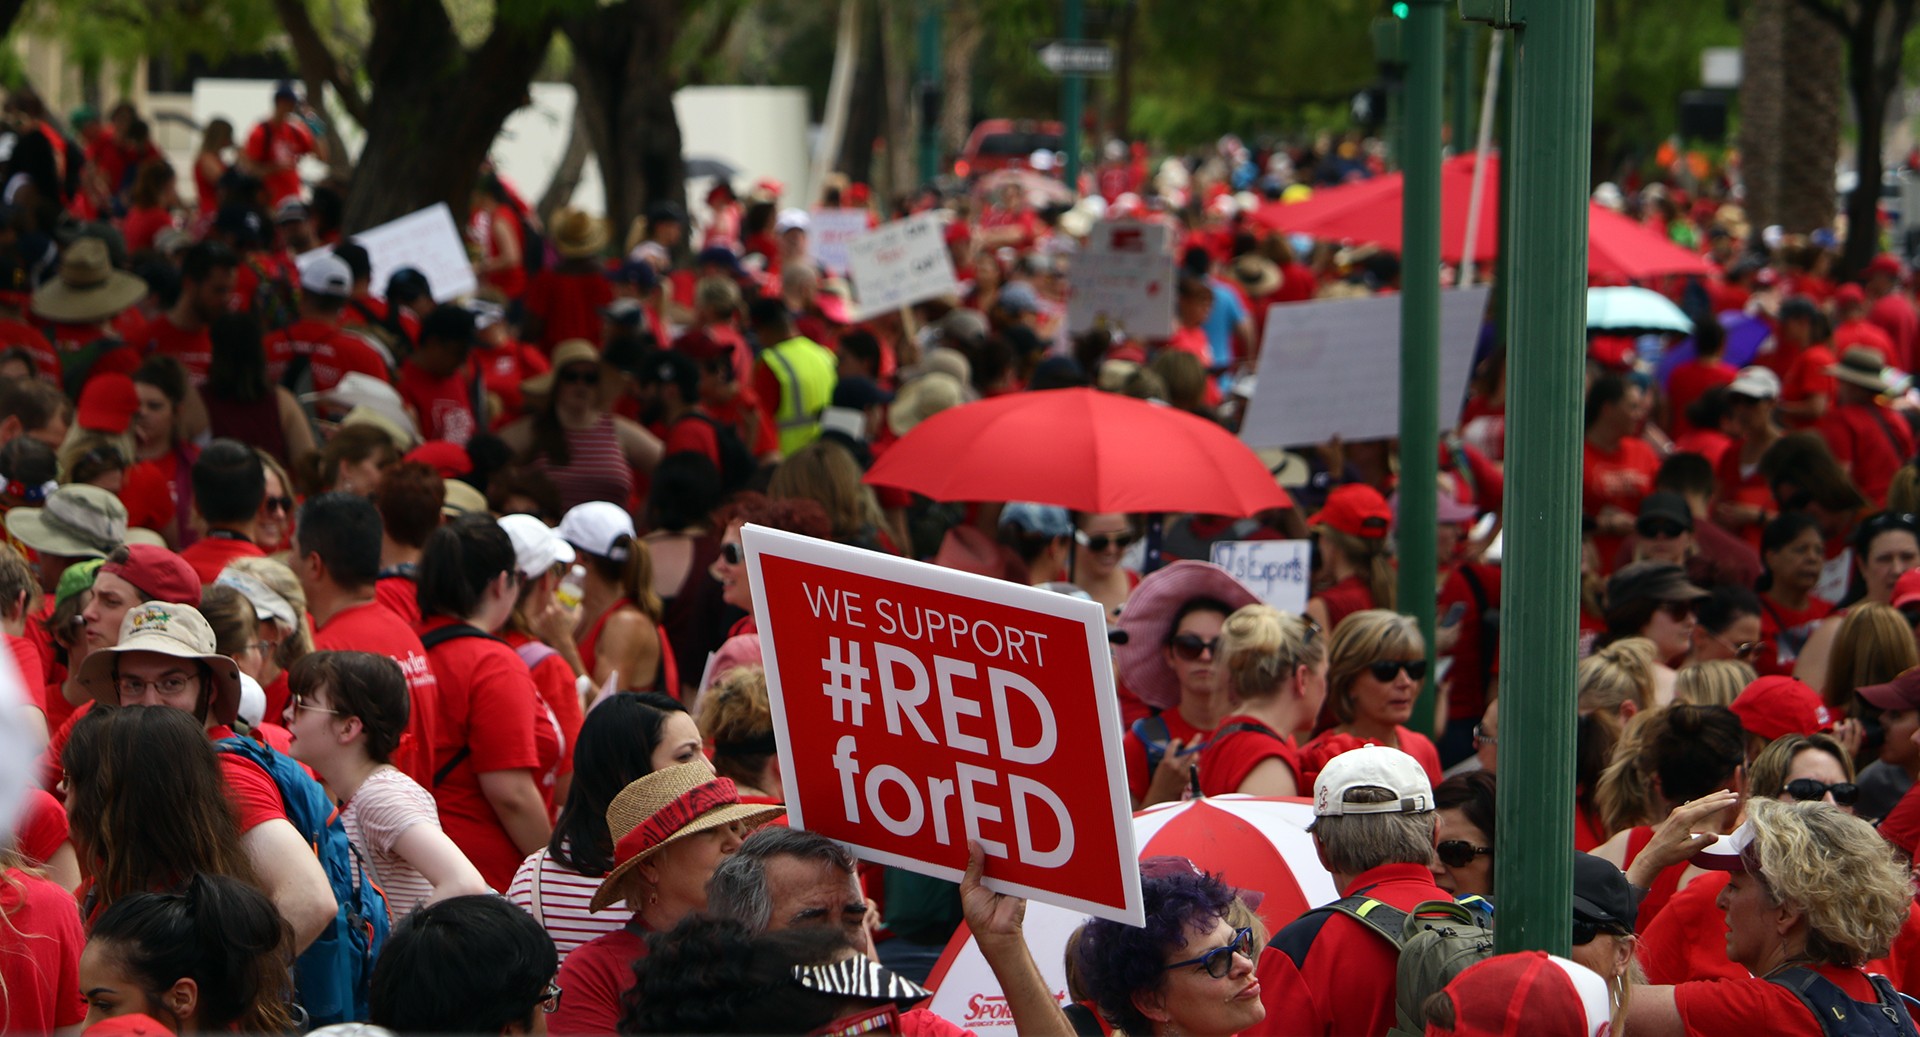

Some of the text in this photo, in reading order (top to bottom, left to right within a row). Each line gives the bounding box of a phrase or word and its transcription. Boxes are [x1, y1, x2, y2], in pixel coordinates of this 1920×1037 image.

[802, 582, 1048, 667] WE SUPPORT
[821, 636, 1058, 765] #RED
[832, 735, 1075, 869] forED
[964, 993, 1013, 1020] SPOR
